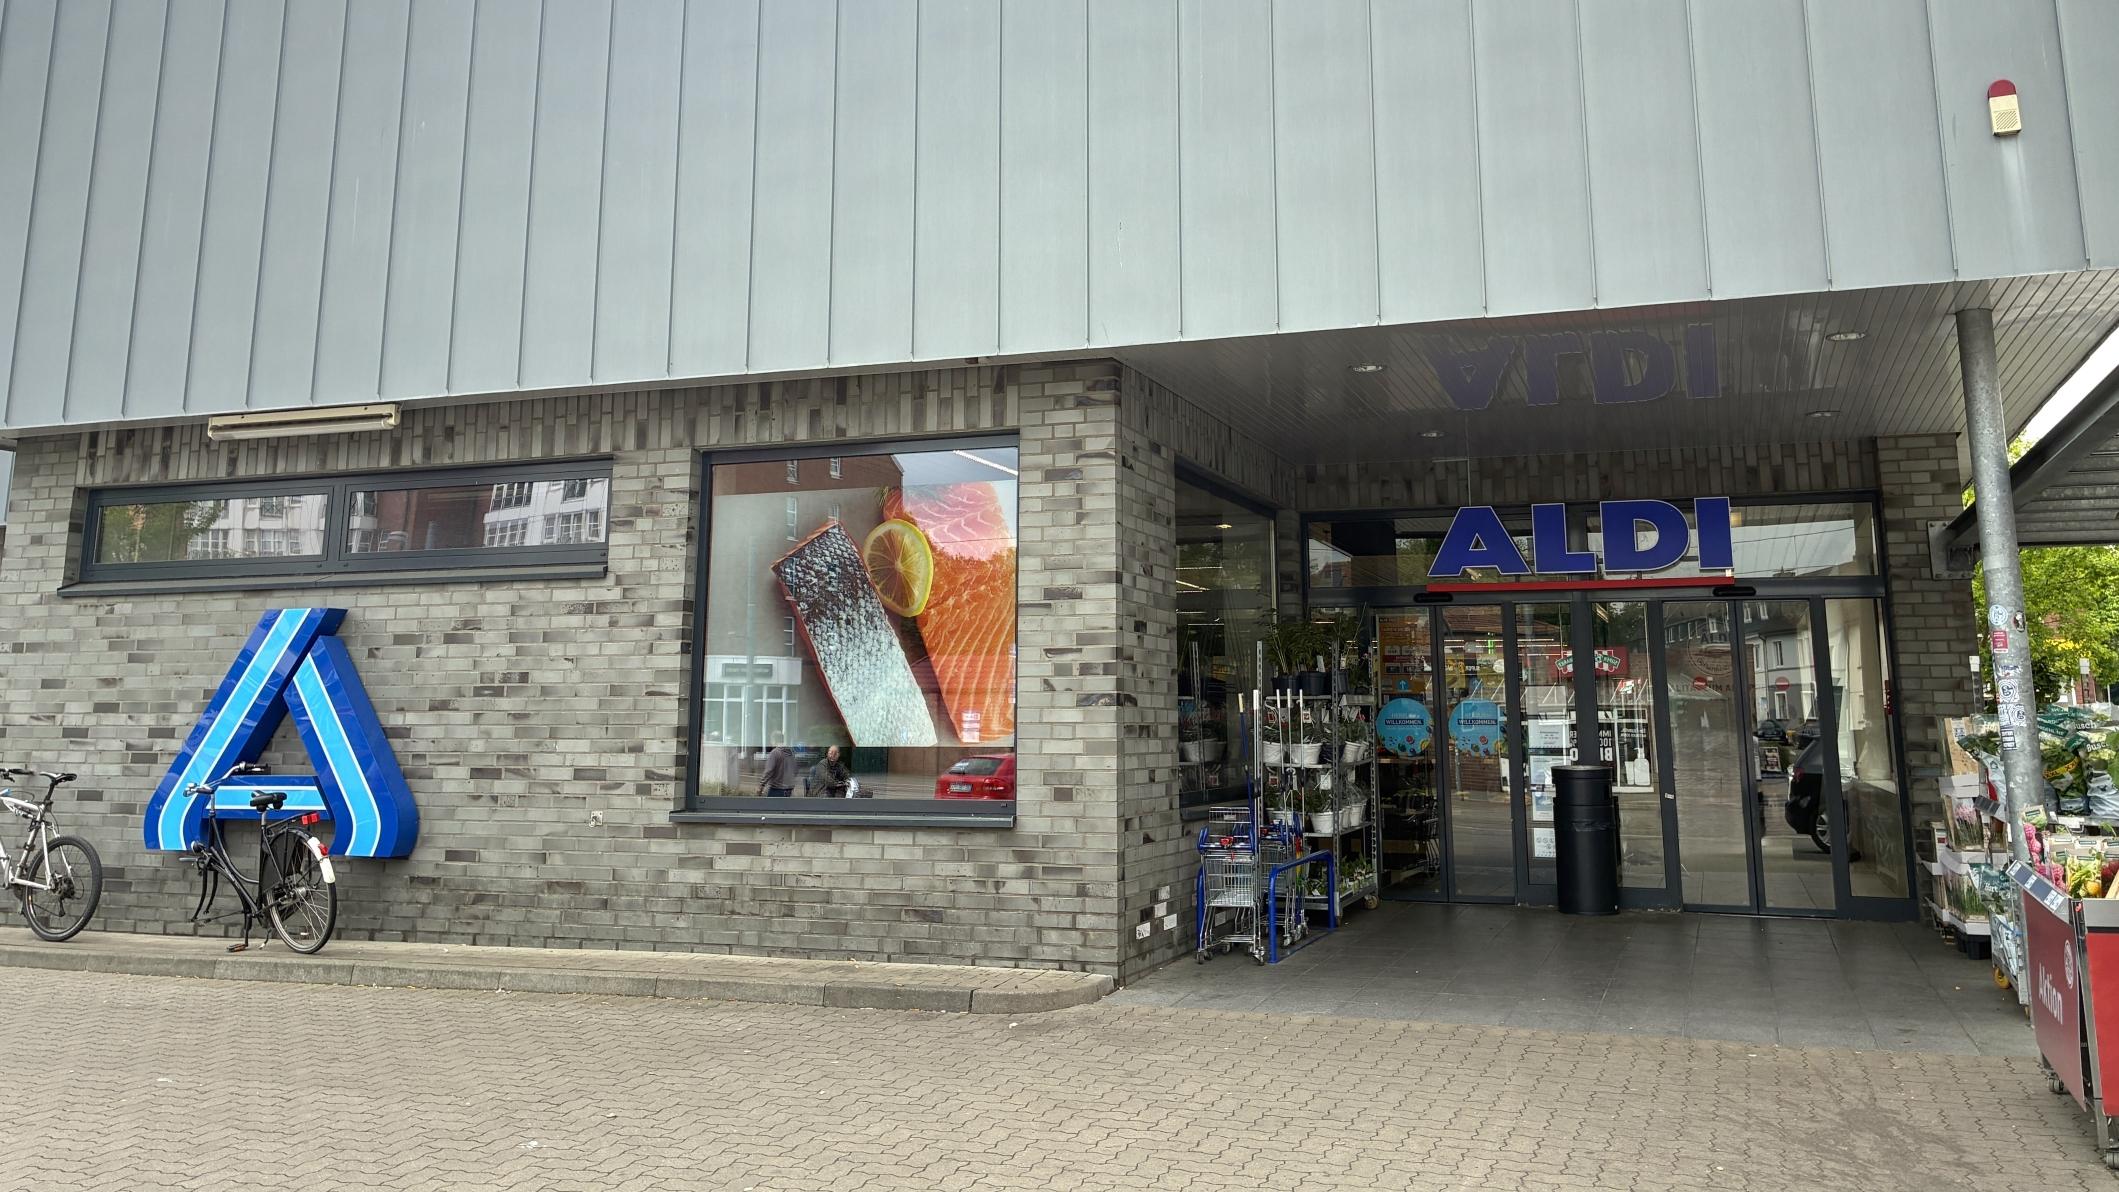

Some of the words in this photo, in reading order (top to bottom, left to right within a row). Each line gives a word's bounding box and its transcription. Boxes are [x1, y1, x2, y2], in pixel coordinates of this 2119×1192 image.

[1427, 496, 1734, 577] ALDI
[2086, 741, 2109, 752] Busc
[2038, 962, 2063, 1025] Aktion
